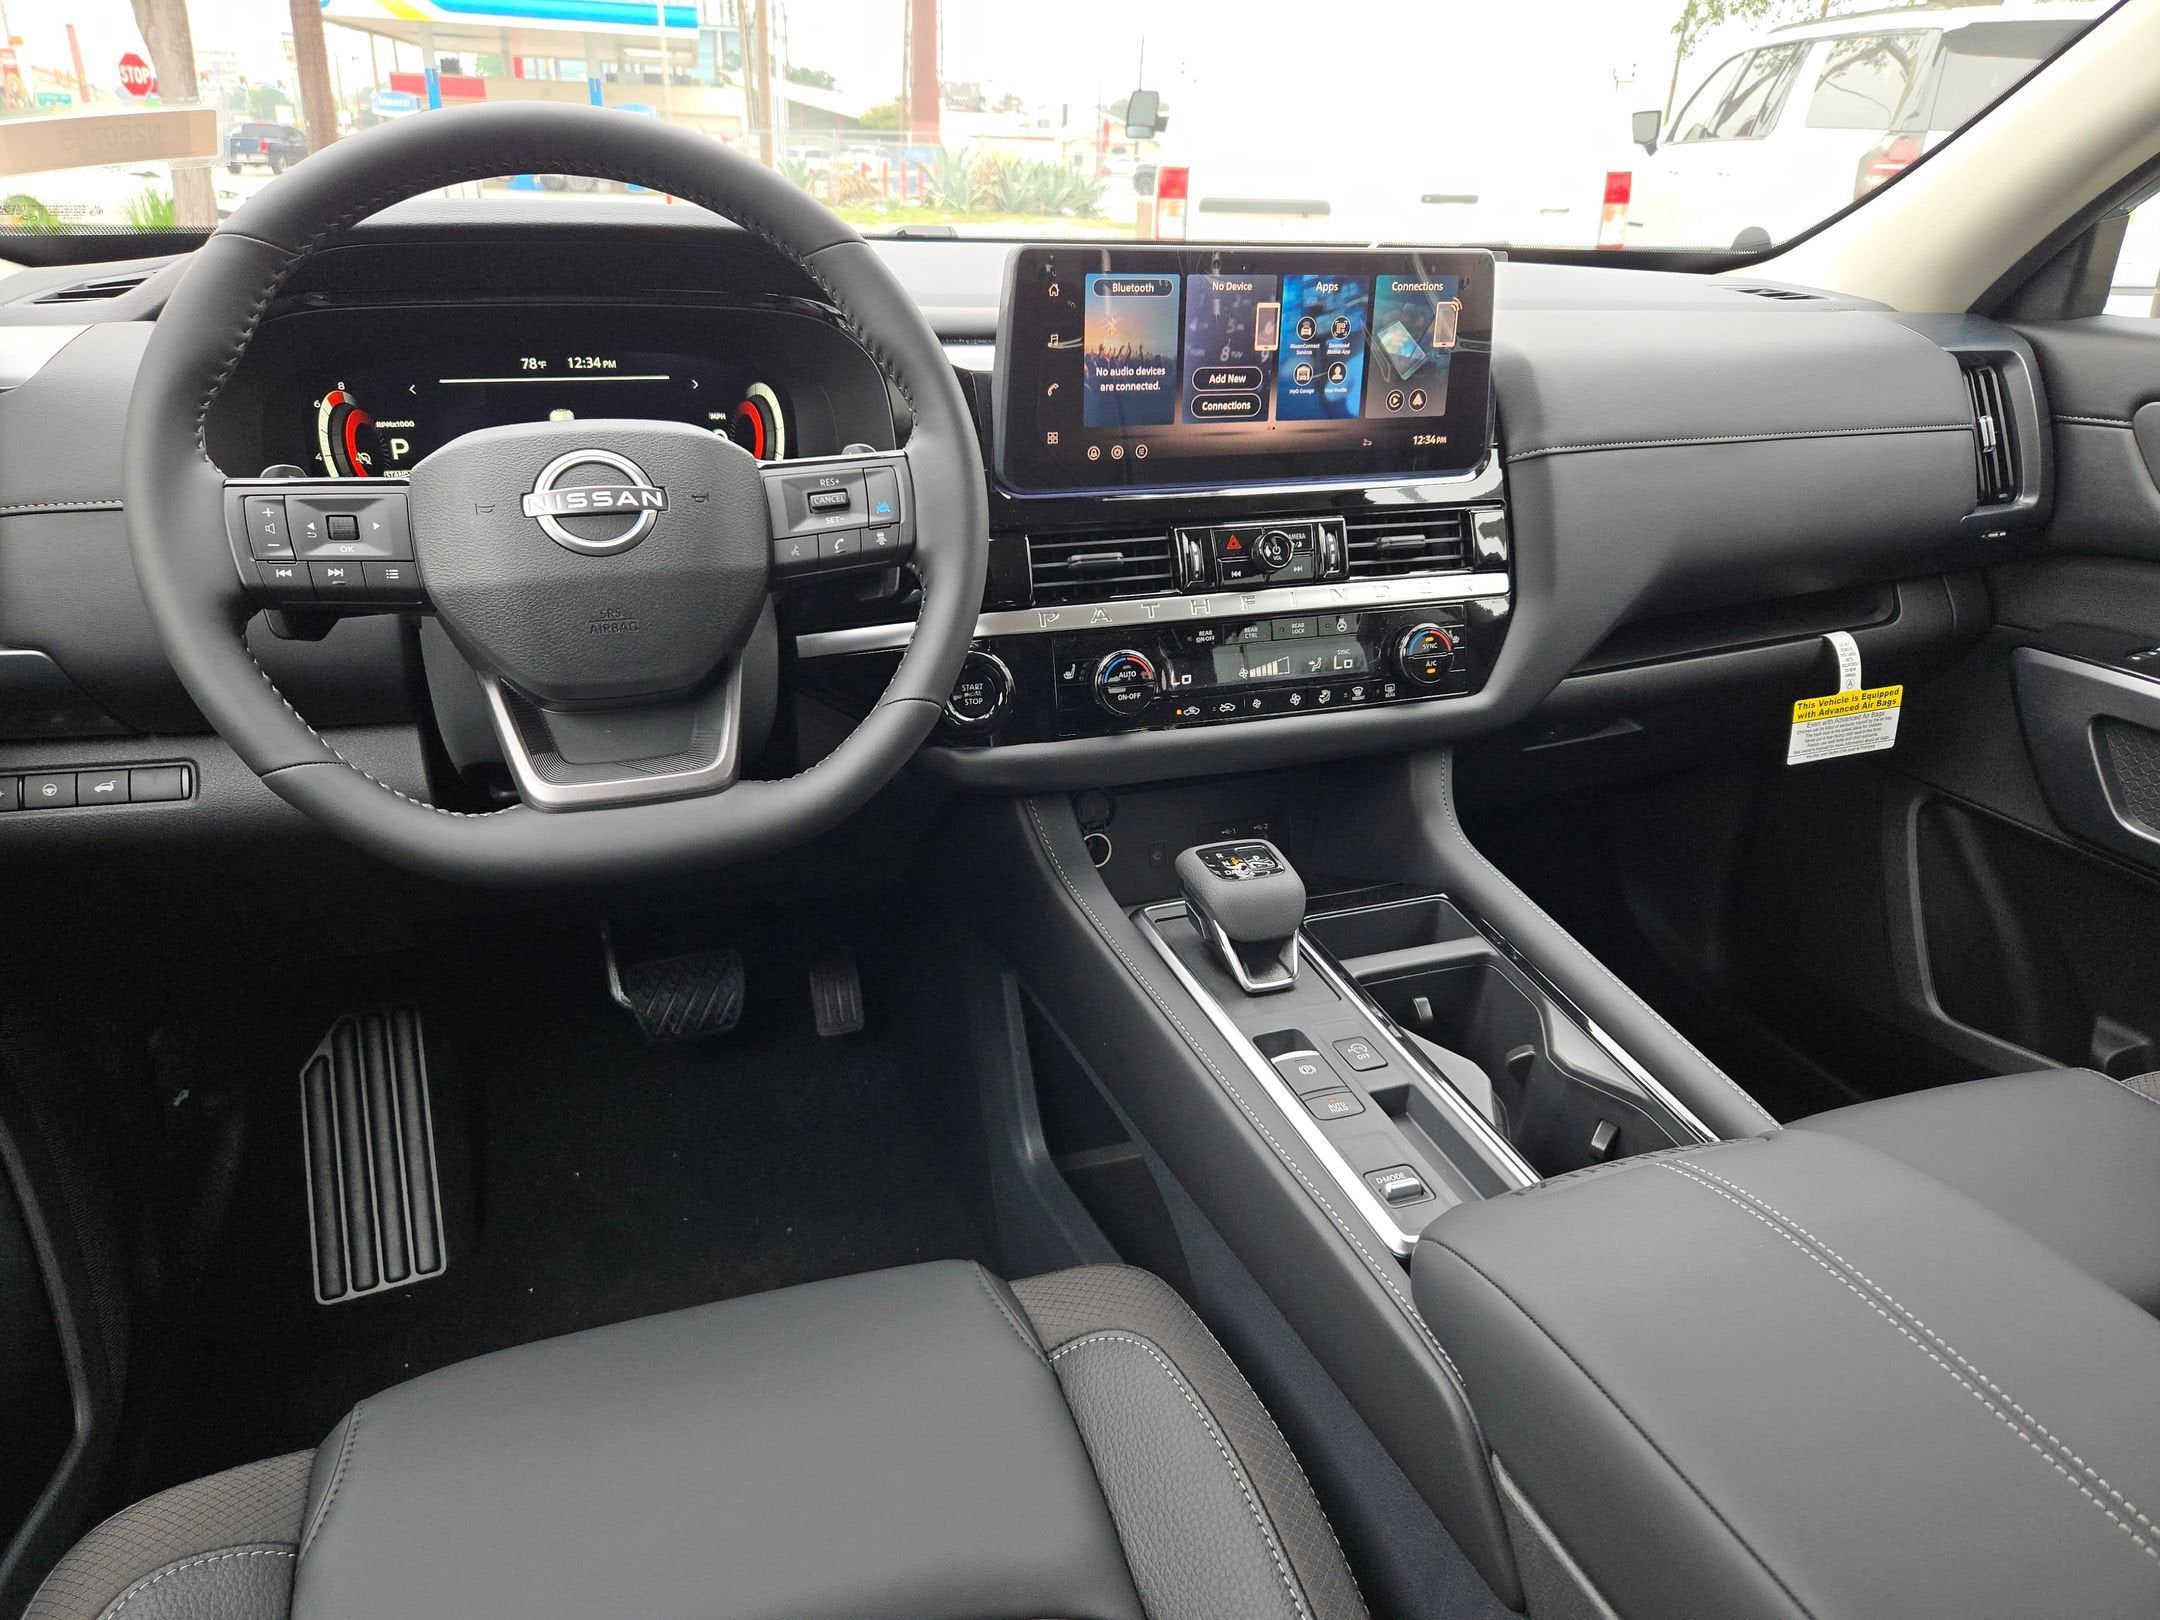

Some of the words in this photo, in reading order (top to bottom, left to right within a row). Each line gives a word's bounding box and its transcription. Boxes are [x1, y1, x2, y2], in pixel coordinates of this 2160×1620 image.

[119, 65, 150, 85] STOP
[1112, 282, 1155, 293] Bluetooth
[1212, 281, 1224, 291] No
[1226, 281, 1253, 291] Device
[1316, 281, 1339, 292] Apps
[1391, 281, 1444, 292] Connections
[567, 356, 601, 369] 12:34
[602, 360, 617, 369] PM
[1096, 367, 1108, 377] No
[1110, 366, 1133, 376] audio
[1135, 365, 1166, 376] devices
[1208, 373, 1227, 384] Add
[1228, 374, 1247, 384] New
[337, 381, 346, 390] 8
[1100, 383, 1114, 392] are
[1116, 380, 1161, 392] connected.
[313, 400, 321, 408] 6
[1202, 400, 1252, 411] Connections
[1413, 434, 1436, 446] 12:34
[1436, 435, 1447, 444] PM
[390, 438, 410, 460] P
[315, 453, 323, 461] 4
[820, 477, 840, 487] RES+
[526, 490, 663, 513] NISSAN
[813, 494, 845, 505] CANCEL
[339, 545, 355, 553] OK
[600, 608, 621, 618] SRS
[589, 621, 639, 634] AIRBAG
[1425, 659, 1437, 667] A/C
[1118, 670, 1137, 679] AUTO
[961, 682, 984, 691] START
[964, 698, 984, 706] STOP
[1117, 692, 1141, 701] ON-OFF
[1797, 702, 1815, 710] This
[1818, 696, 1850, 707] Vehicle
[1851, 694, 1859, 702] is
[1861, 688, 1899, 701] Equipped
[1797, 711, 1816, 719] with
[1819, 703, 1859, 716] Advanced
[1876, 698, 1897, 707] Bags
